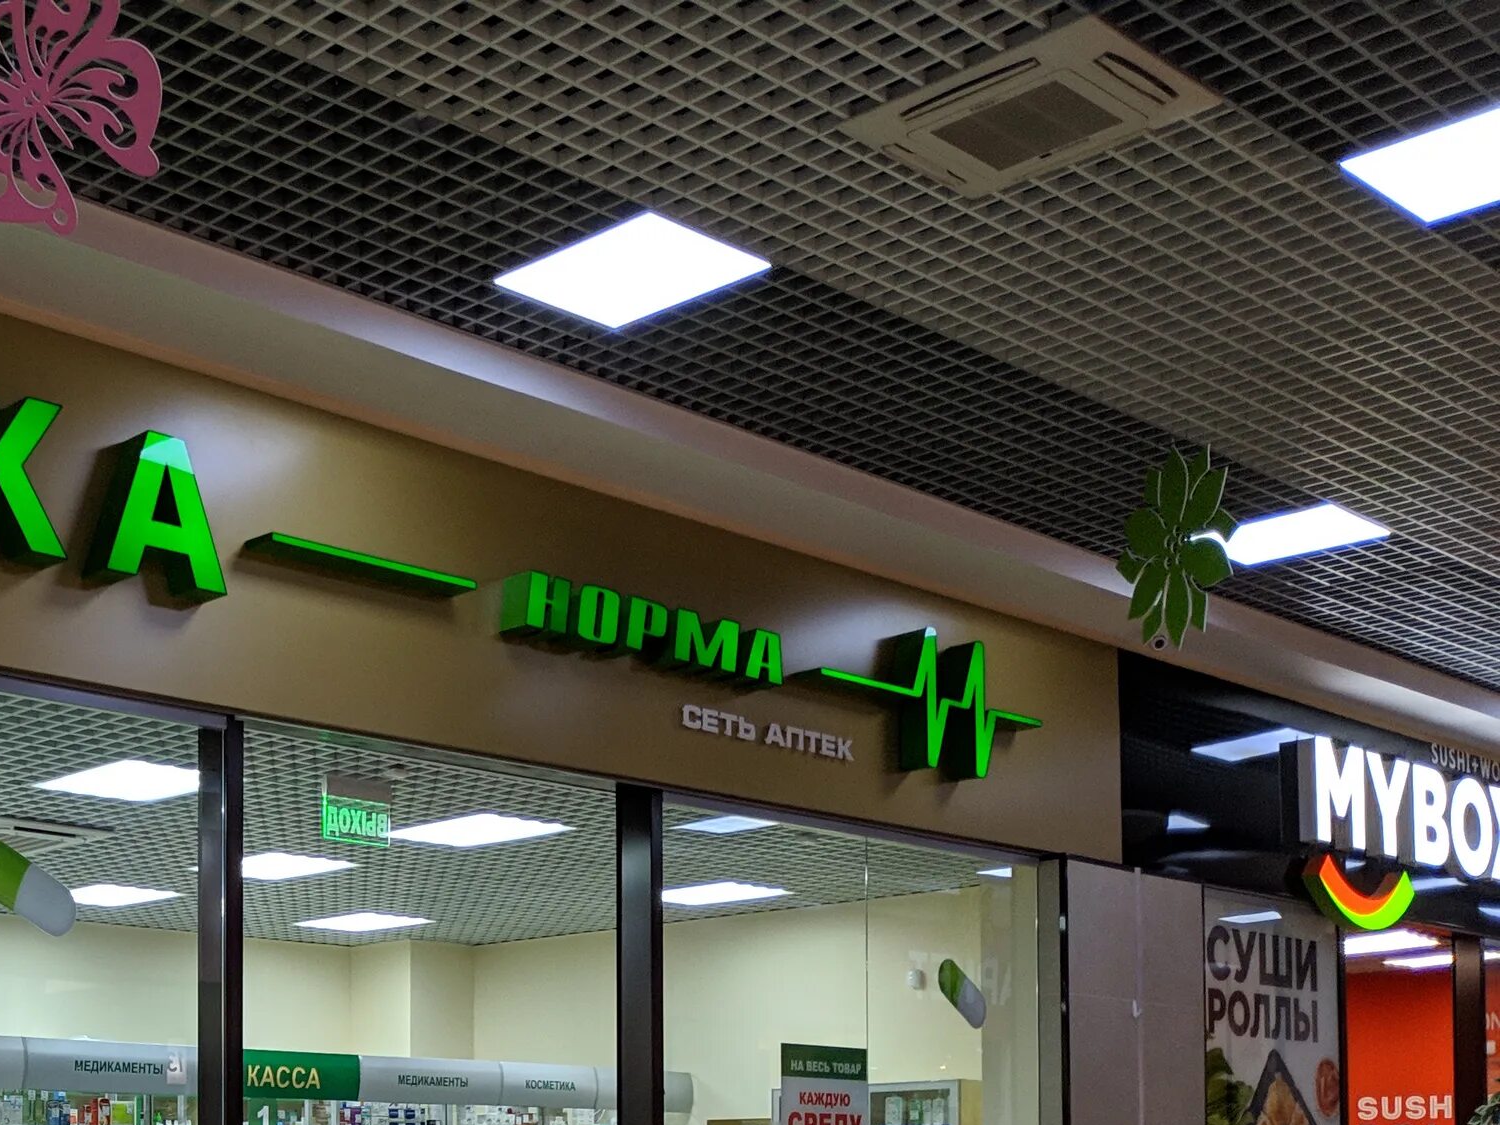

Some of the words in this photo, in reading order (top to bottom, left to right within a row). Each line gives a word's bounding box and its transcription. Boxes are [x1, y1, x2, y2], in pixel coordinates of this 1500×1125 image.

[506, 570, 783, 686] НОРМА
[681, 703, 756, 742] СЕТЬ
[765, 722, 855, 762] АПТЕК
[1313, 735, 1500, 881] MYBO
[1206, 925, 1319, 992] СУШИ
[1207, 987, 1319, 1043] РОЛЛЫ
[74, 1059, 163, 1075] МЕДИКАМЕНТЫ
[246, 1065, 322, 1090] КАССА
[791, 1059, 804, 1071] НА
[806, 1061, 829, 1073] ВЕСЬ
[832, 1062, 862, 1075] ТОВАР
[397, 1074, 468, 1088] МЕДИКАМЕНТЫ
[525, 1079, 576, 1092] КОСМЕТИКА
[799, 1091, 851, 1108] КАЖДУЮ
